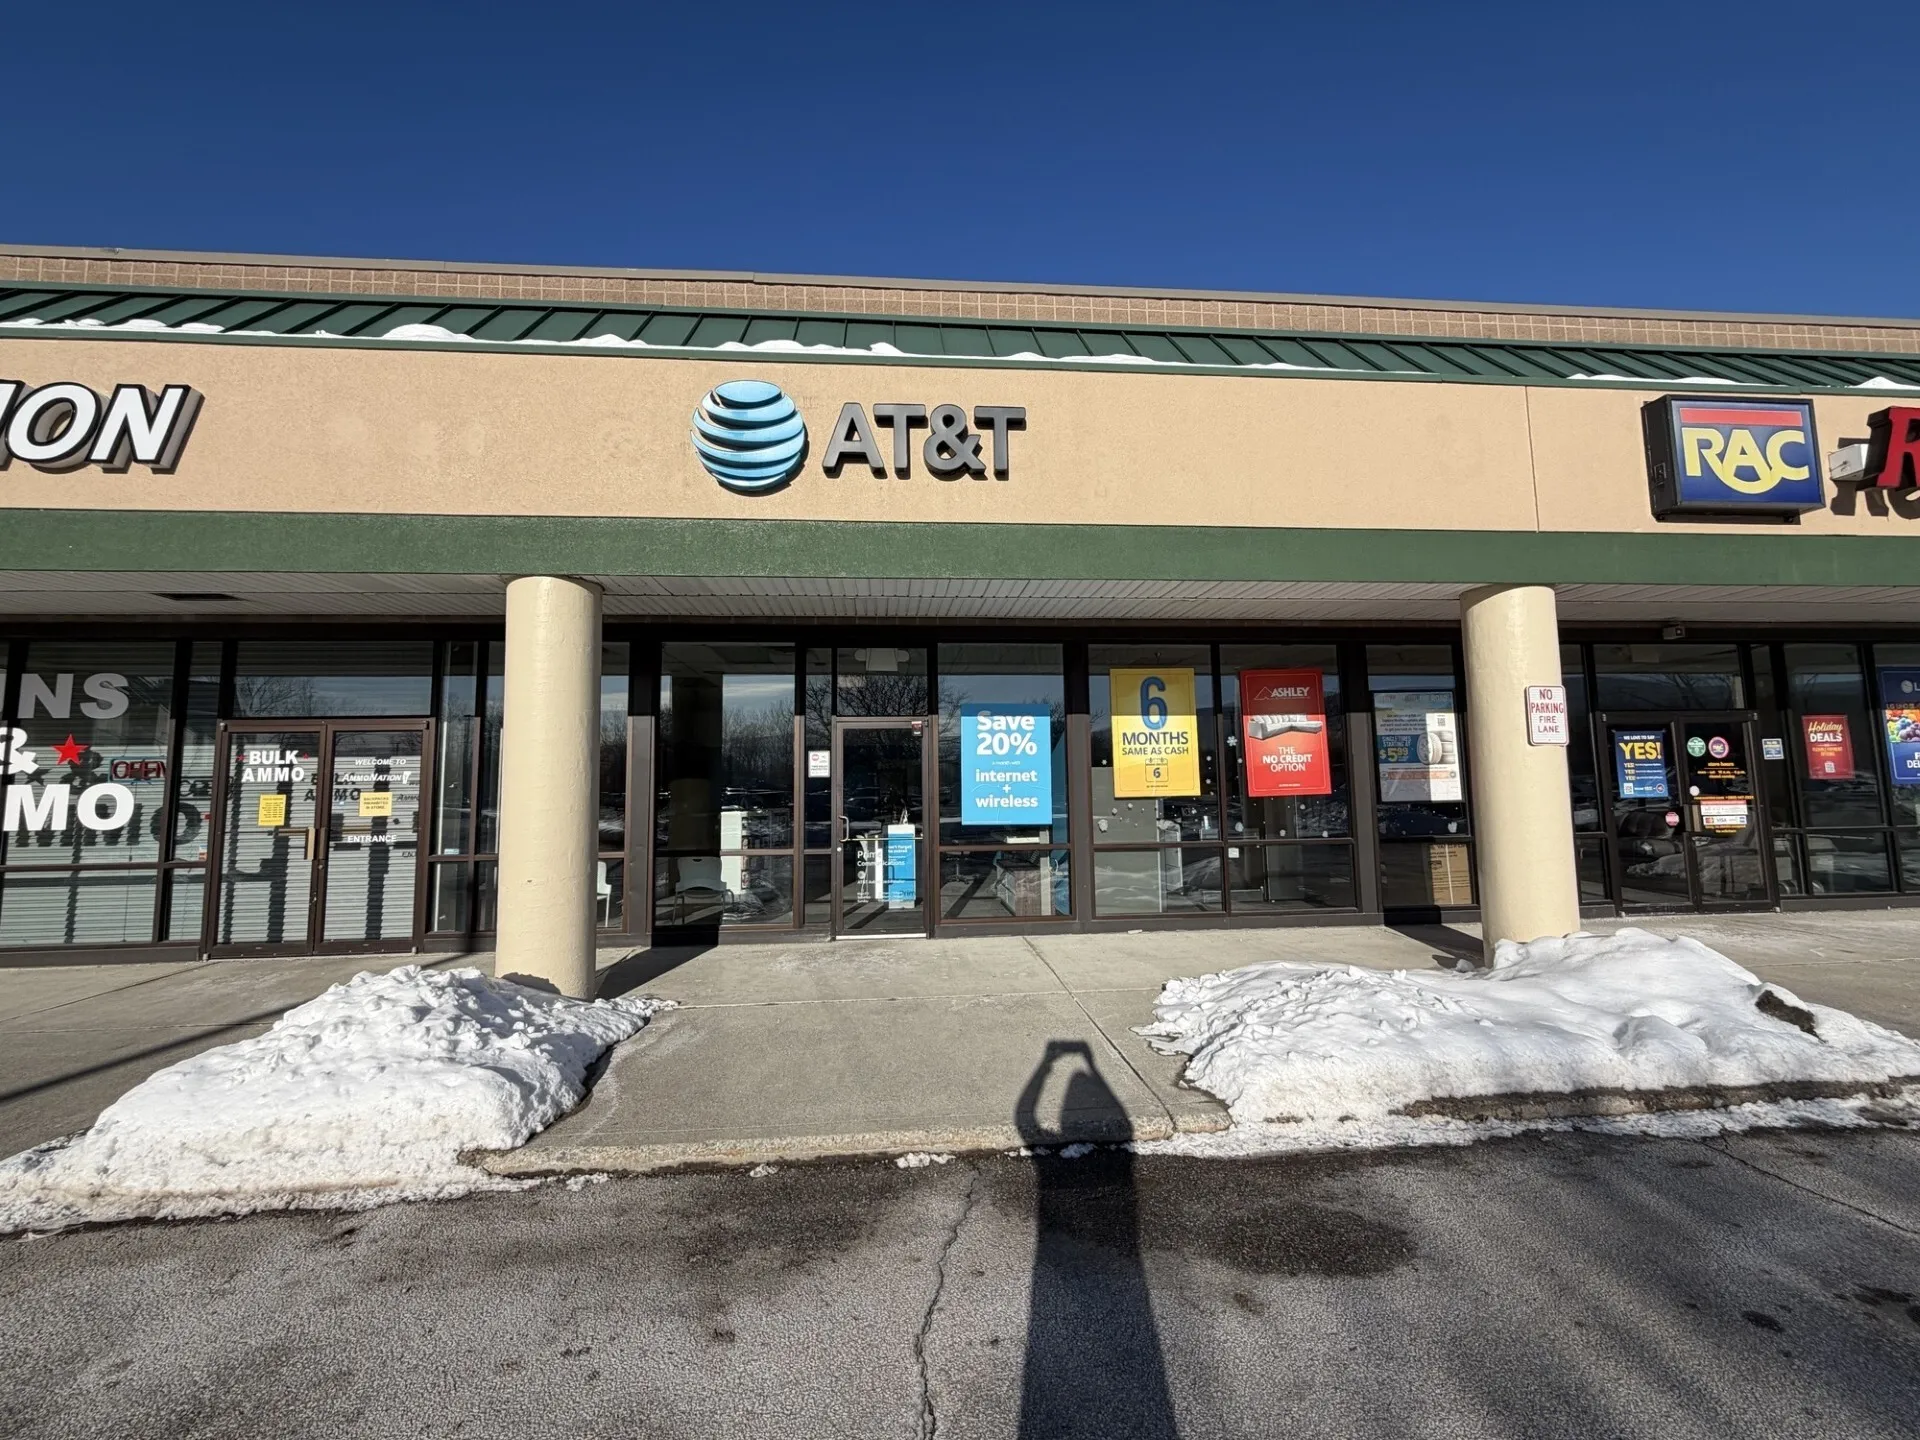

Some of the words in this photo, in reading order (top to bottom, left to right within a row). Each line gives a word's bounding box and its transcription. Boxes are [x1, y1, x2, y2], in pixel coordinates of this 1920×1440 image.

[822, 402, 1026, 480] AT&T
[1681, 427, 1810, 494] RAC
[0, 670, 130, 719] NS
[1271, 687, 1310, 698] ASHLEY
[1539, 689, 1553, 700] NO
[1140, 676, 1168, 730] 6
[1531, 702, 1564, 714] PARKING
[977, 710, 1035, 731] Save
[1537, 725, 1560, 733] LANE
[1808, 721, 1843, 734] Holiday
[1122, 731, 1189, 745] MONTHS
[1810, 732, 1842, 742] DEALS
[976, 732, 1038, 756] 20%
[1122, 747, 1148, 755] SAME
[1150, 747, 1162, 755] AS
[1164, 746, 1189, 755] CASH
[1278, 746, 1296, 755] THE
[1619, 741, 1662, 760] YES!
[249, 750, 299, 765] BULK
[1262, 755, 1278, 764] NO
[1280, 754, 1312, 763] CREDIT
[1153, 767, 1161, 778] 6
[1270, 763, 1306, 772] OPTION
[241, 767, 305, 782] AMMO
[975, 768, 1038, 782] internet
[975, 794, 1039, 808] wireless
[347, 834, 397, 843] ENTRANCE
